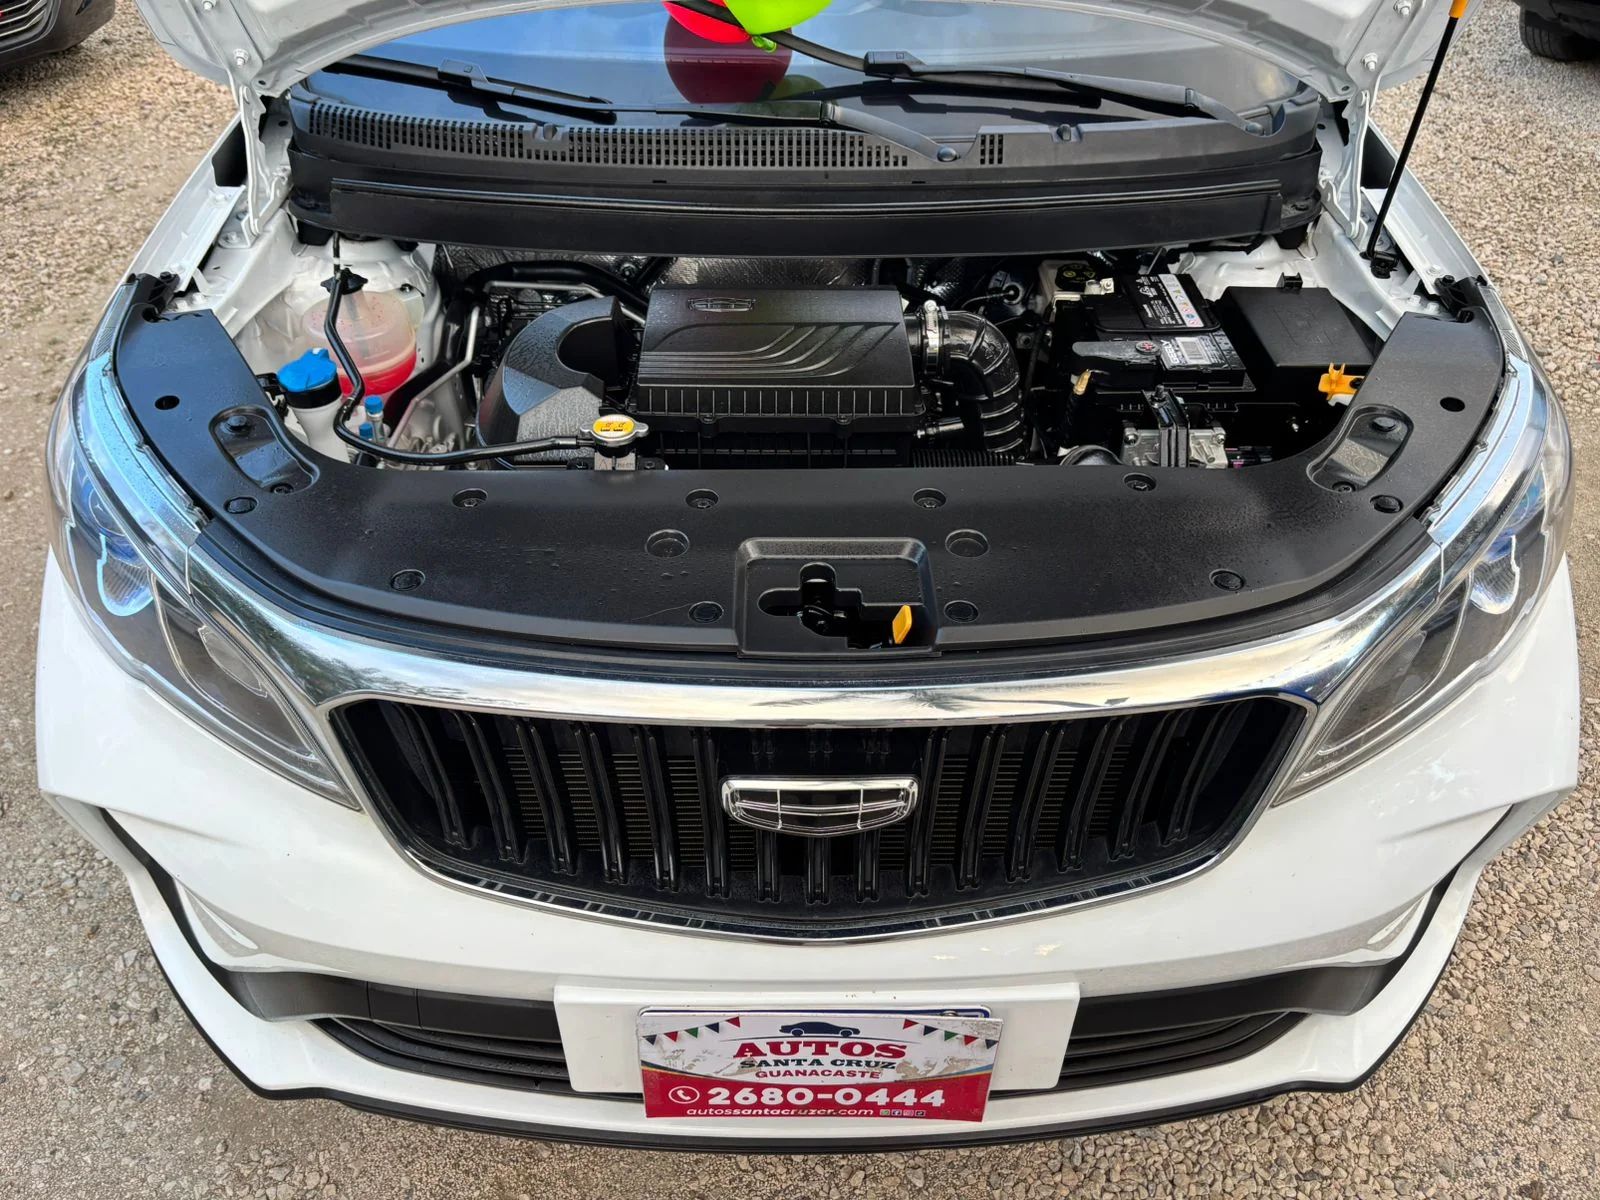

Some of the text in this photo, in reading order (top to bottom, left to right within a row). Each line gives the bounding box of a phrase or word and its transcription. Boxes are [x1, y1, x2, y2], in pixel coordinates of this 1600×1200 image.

[1160, 339, 1180, 364] GEELY
[733, 1041, 906, 1058] AUTOS
[740, 1059, 897, 1069] SANTA CRUZ
[755, 1070, 880, 1080] GUANACASTE
[707, 1087, 945, 1107] 2680-0444
[686, 1108, 874, 1116] autossantacruzcr.com
